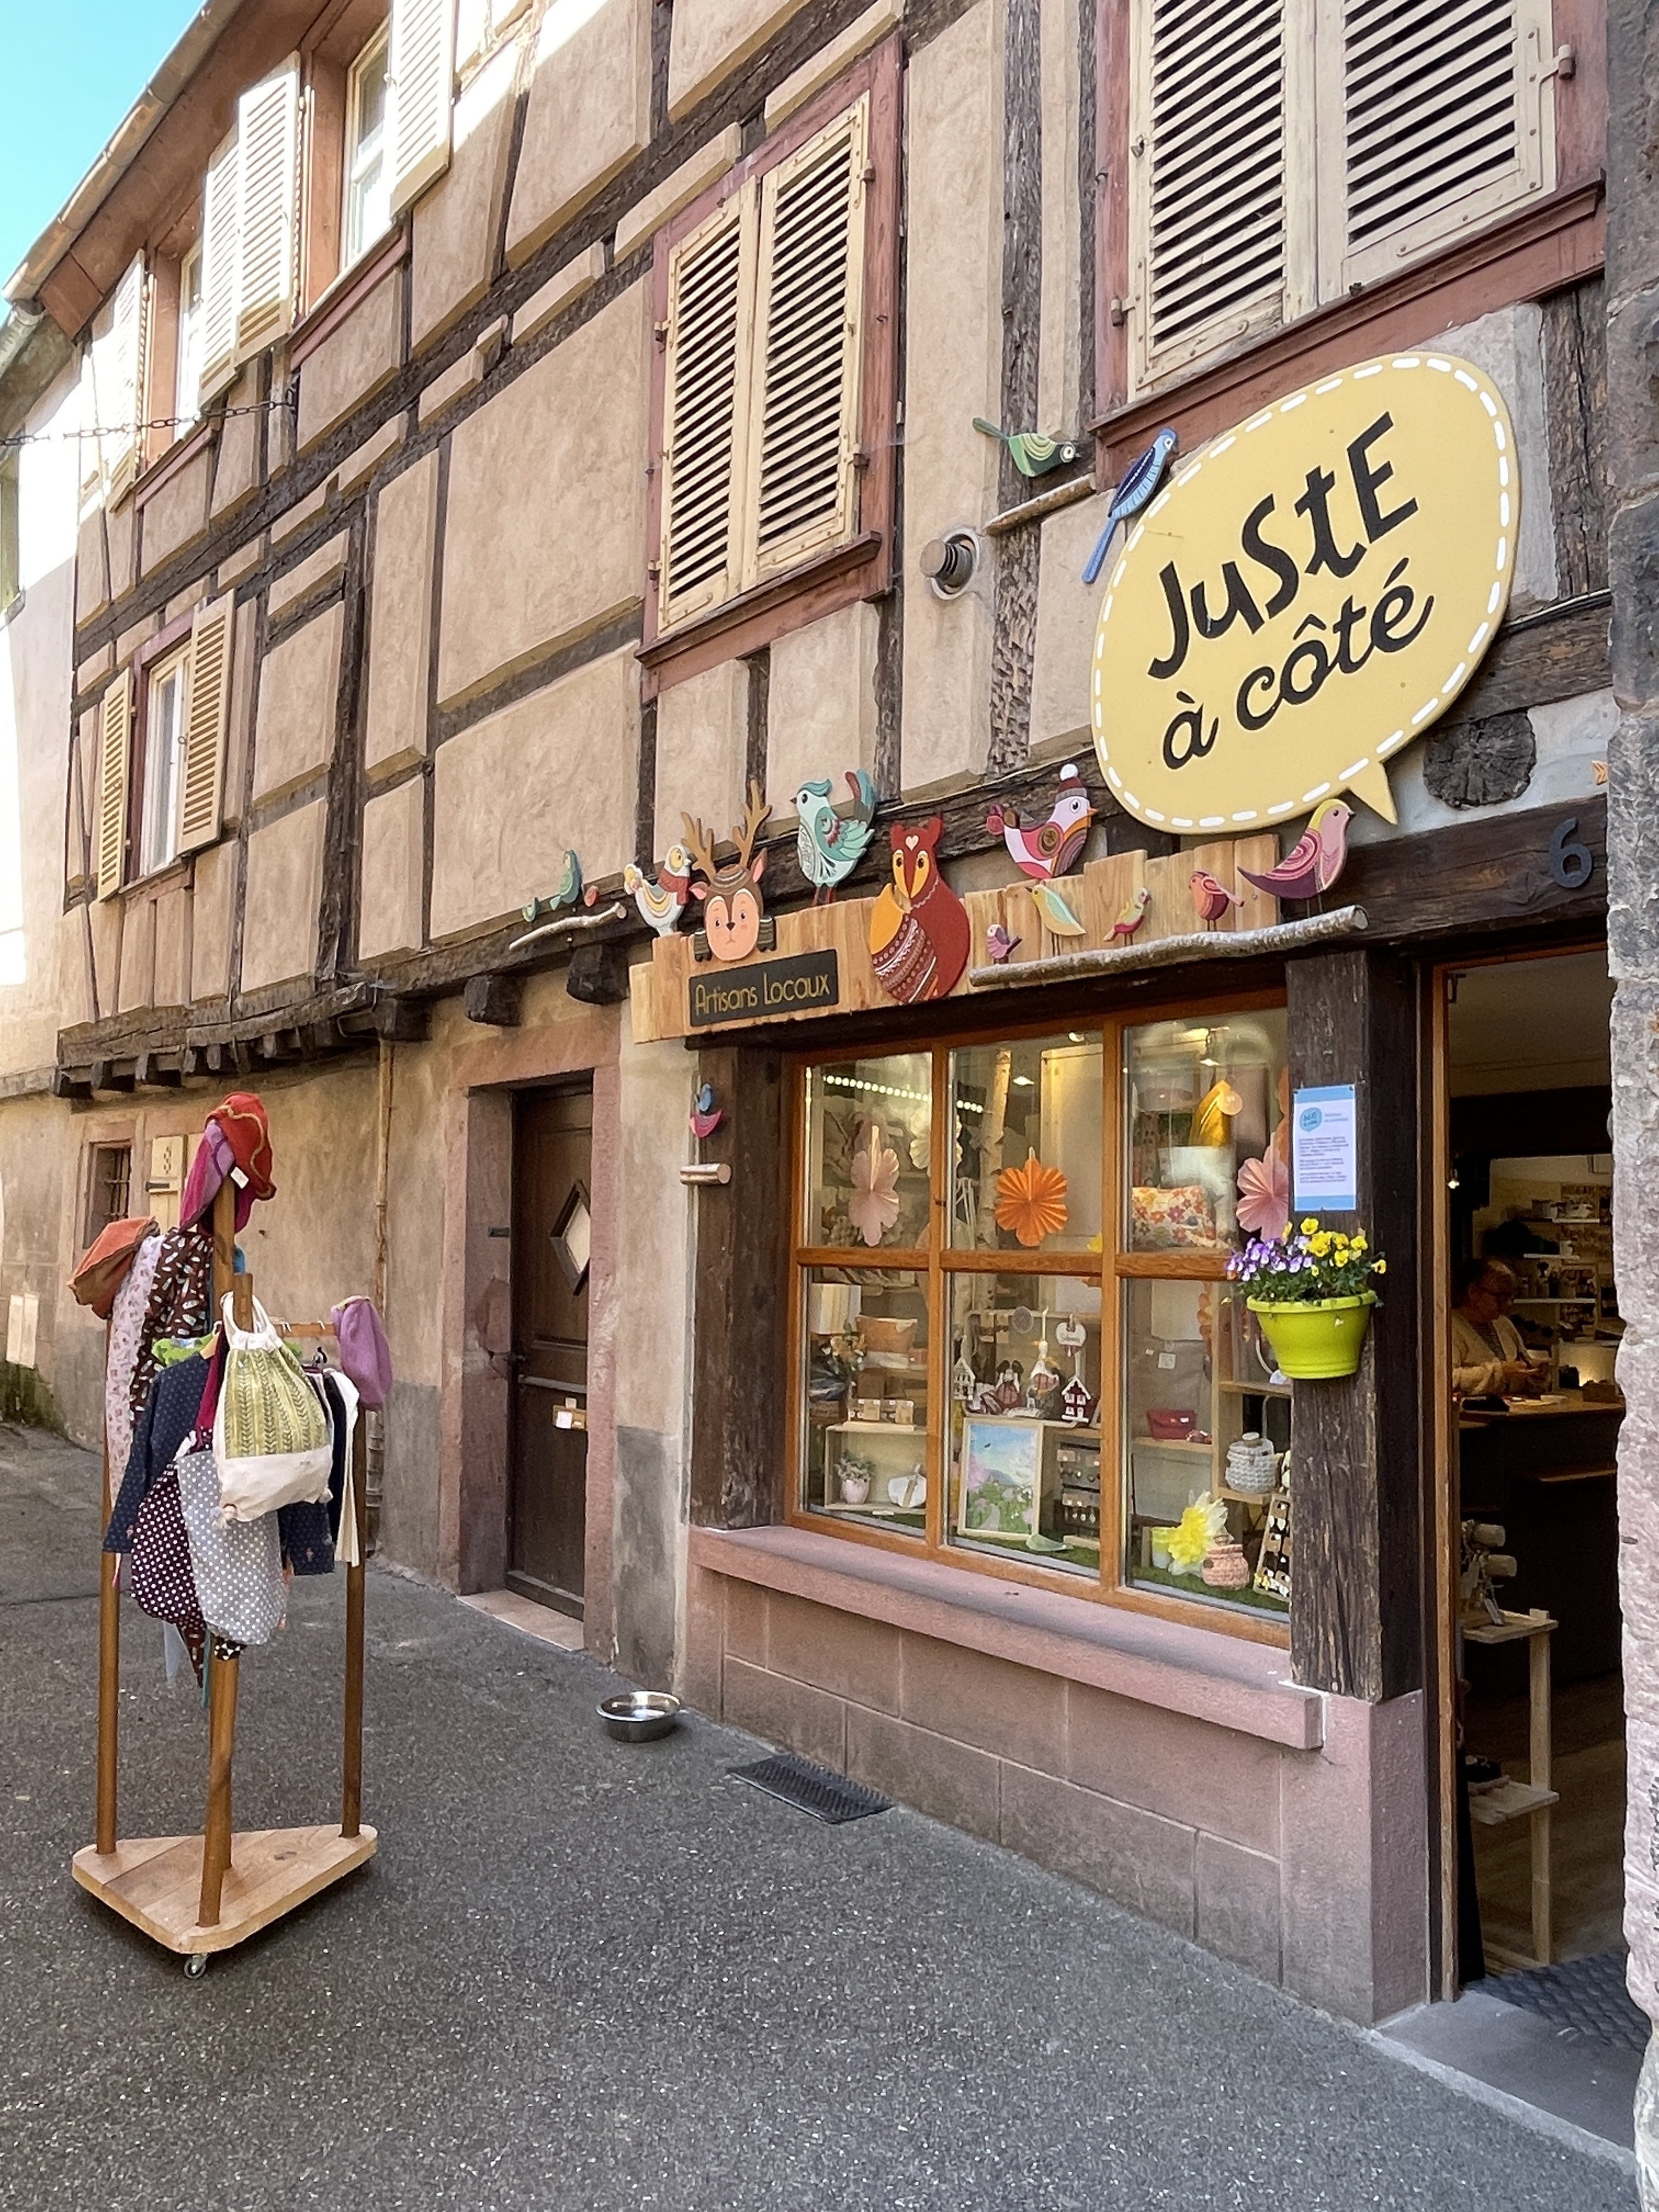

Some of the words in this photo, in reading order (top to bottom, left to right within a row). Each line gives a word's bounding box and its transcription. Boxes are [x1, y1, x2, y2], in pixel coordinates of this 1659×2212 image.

[1162, 691, 1220, 770] à
[1235, 557, 1435, 731] côté
[1549, 816, 1592, 888] 6
[695, 984, 758, 1017] Artisans
[763, 972, 831, 1005] Locaux
